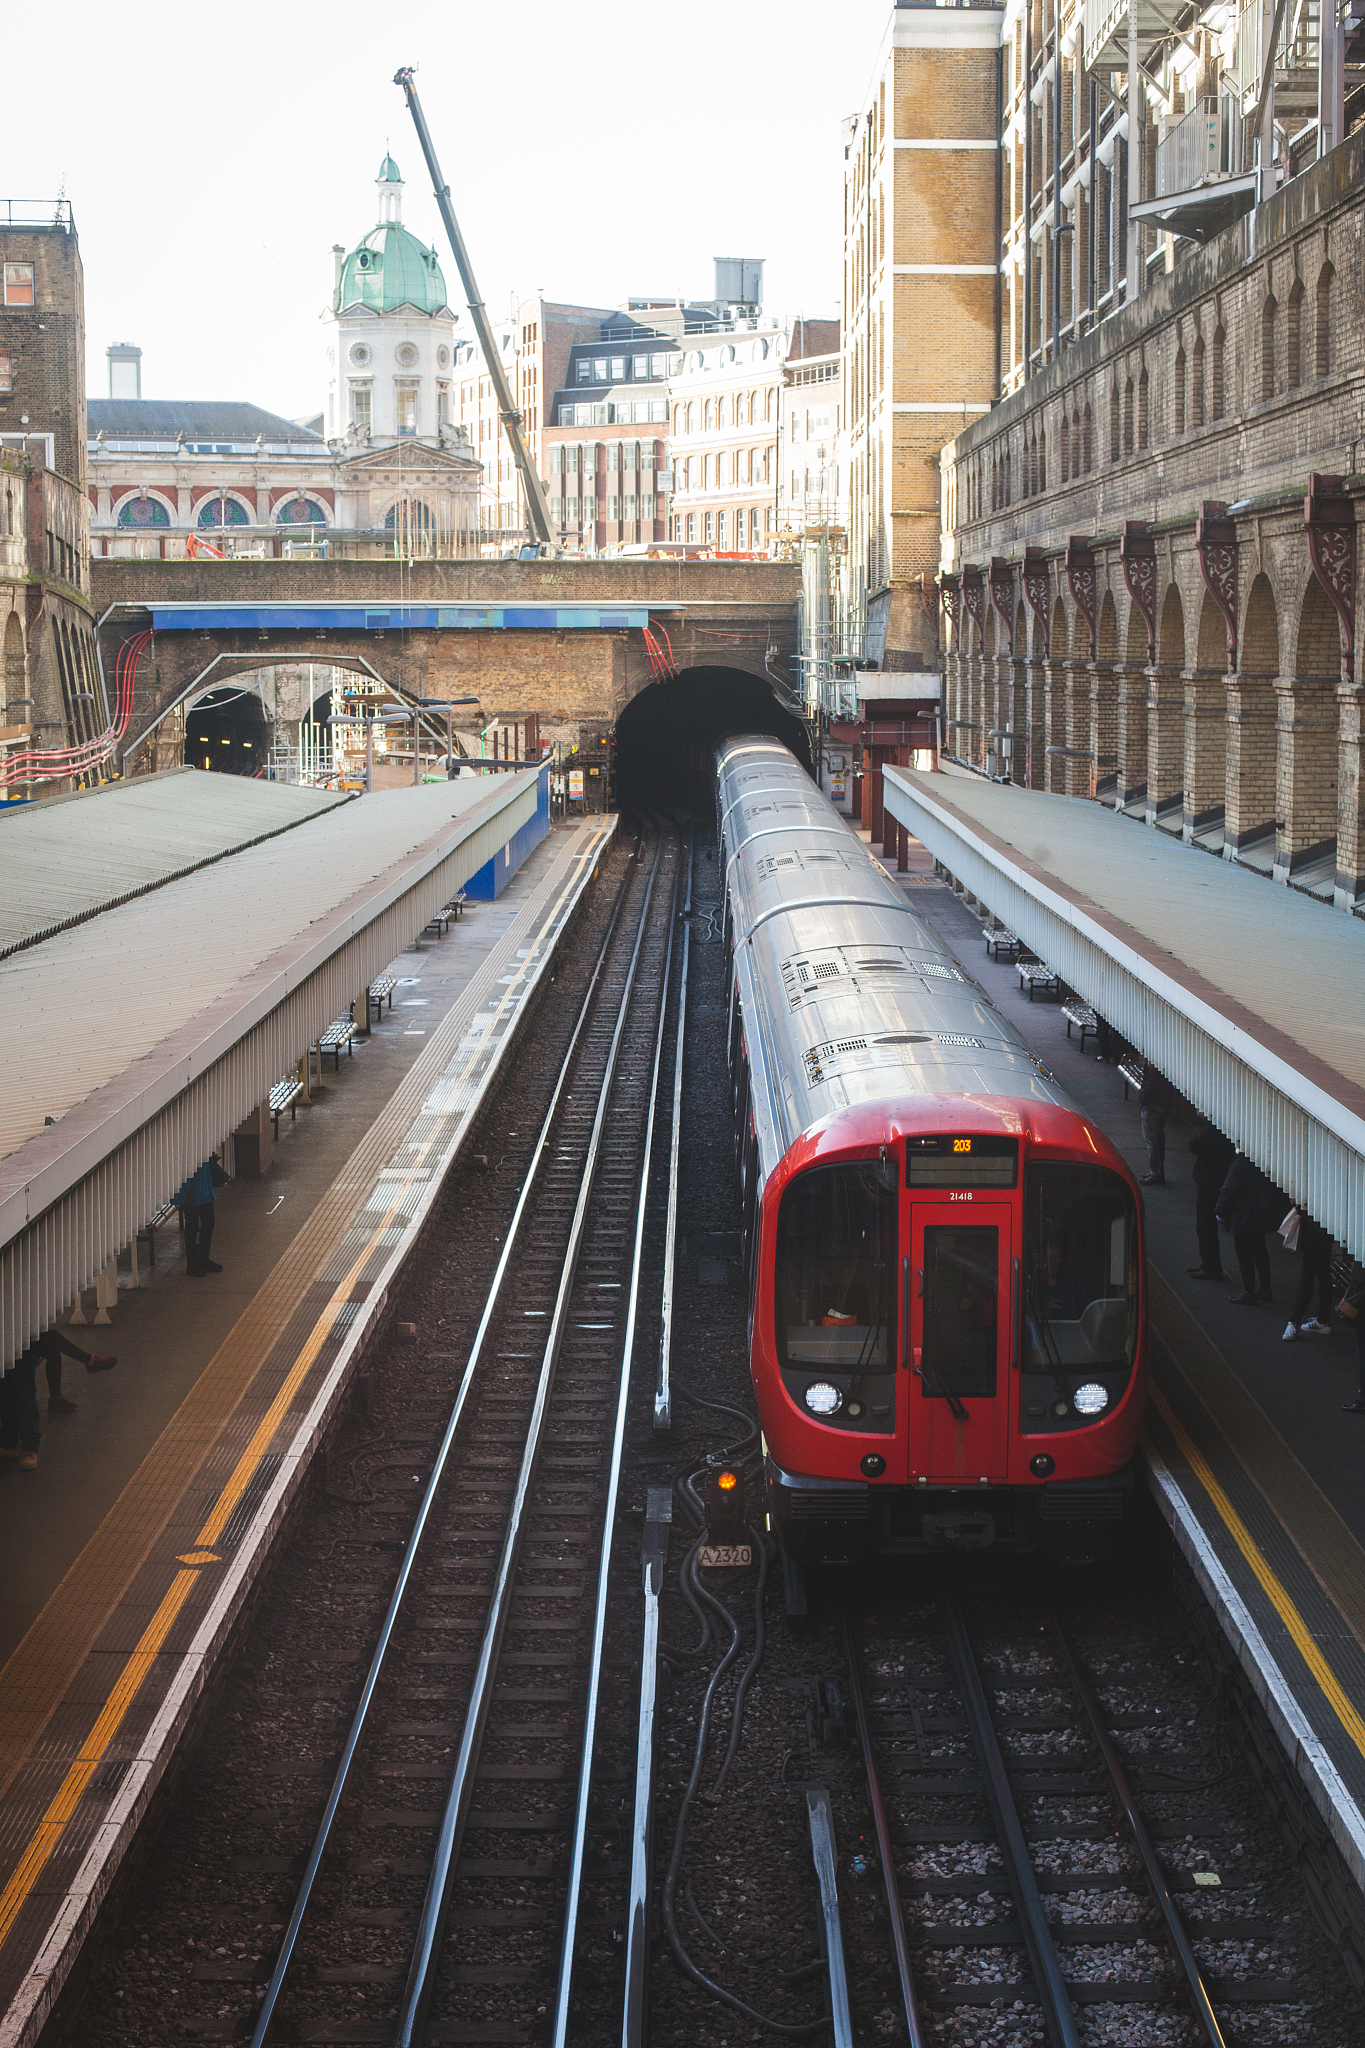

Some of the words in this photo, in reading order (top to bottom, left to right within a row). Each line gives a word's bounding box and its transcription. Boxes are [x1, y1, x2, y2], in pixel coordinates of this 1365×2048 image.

[953, 1139, 971, 1152] 203
[949, 1192, 973, 1200] 21418
[700, 1548, 751, 1563] A2320
